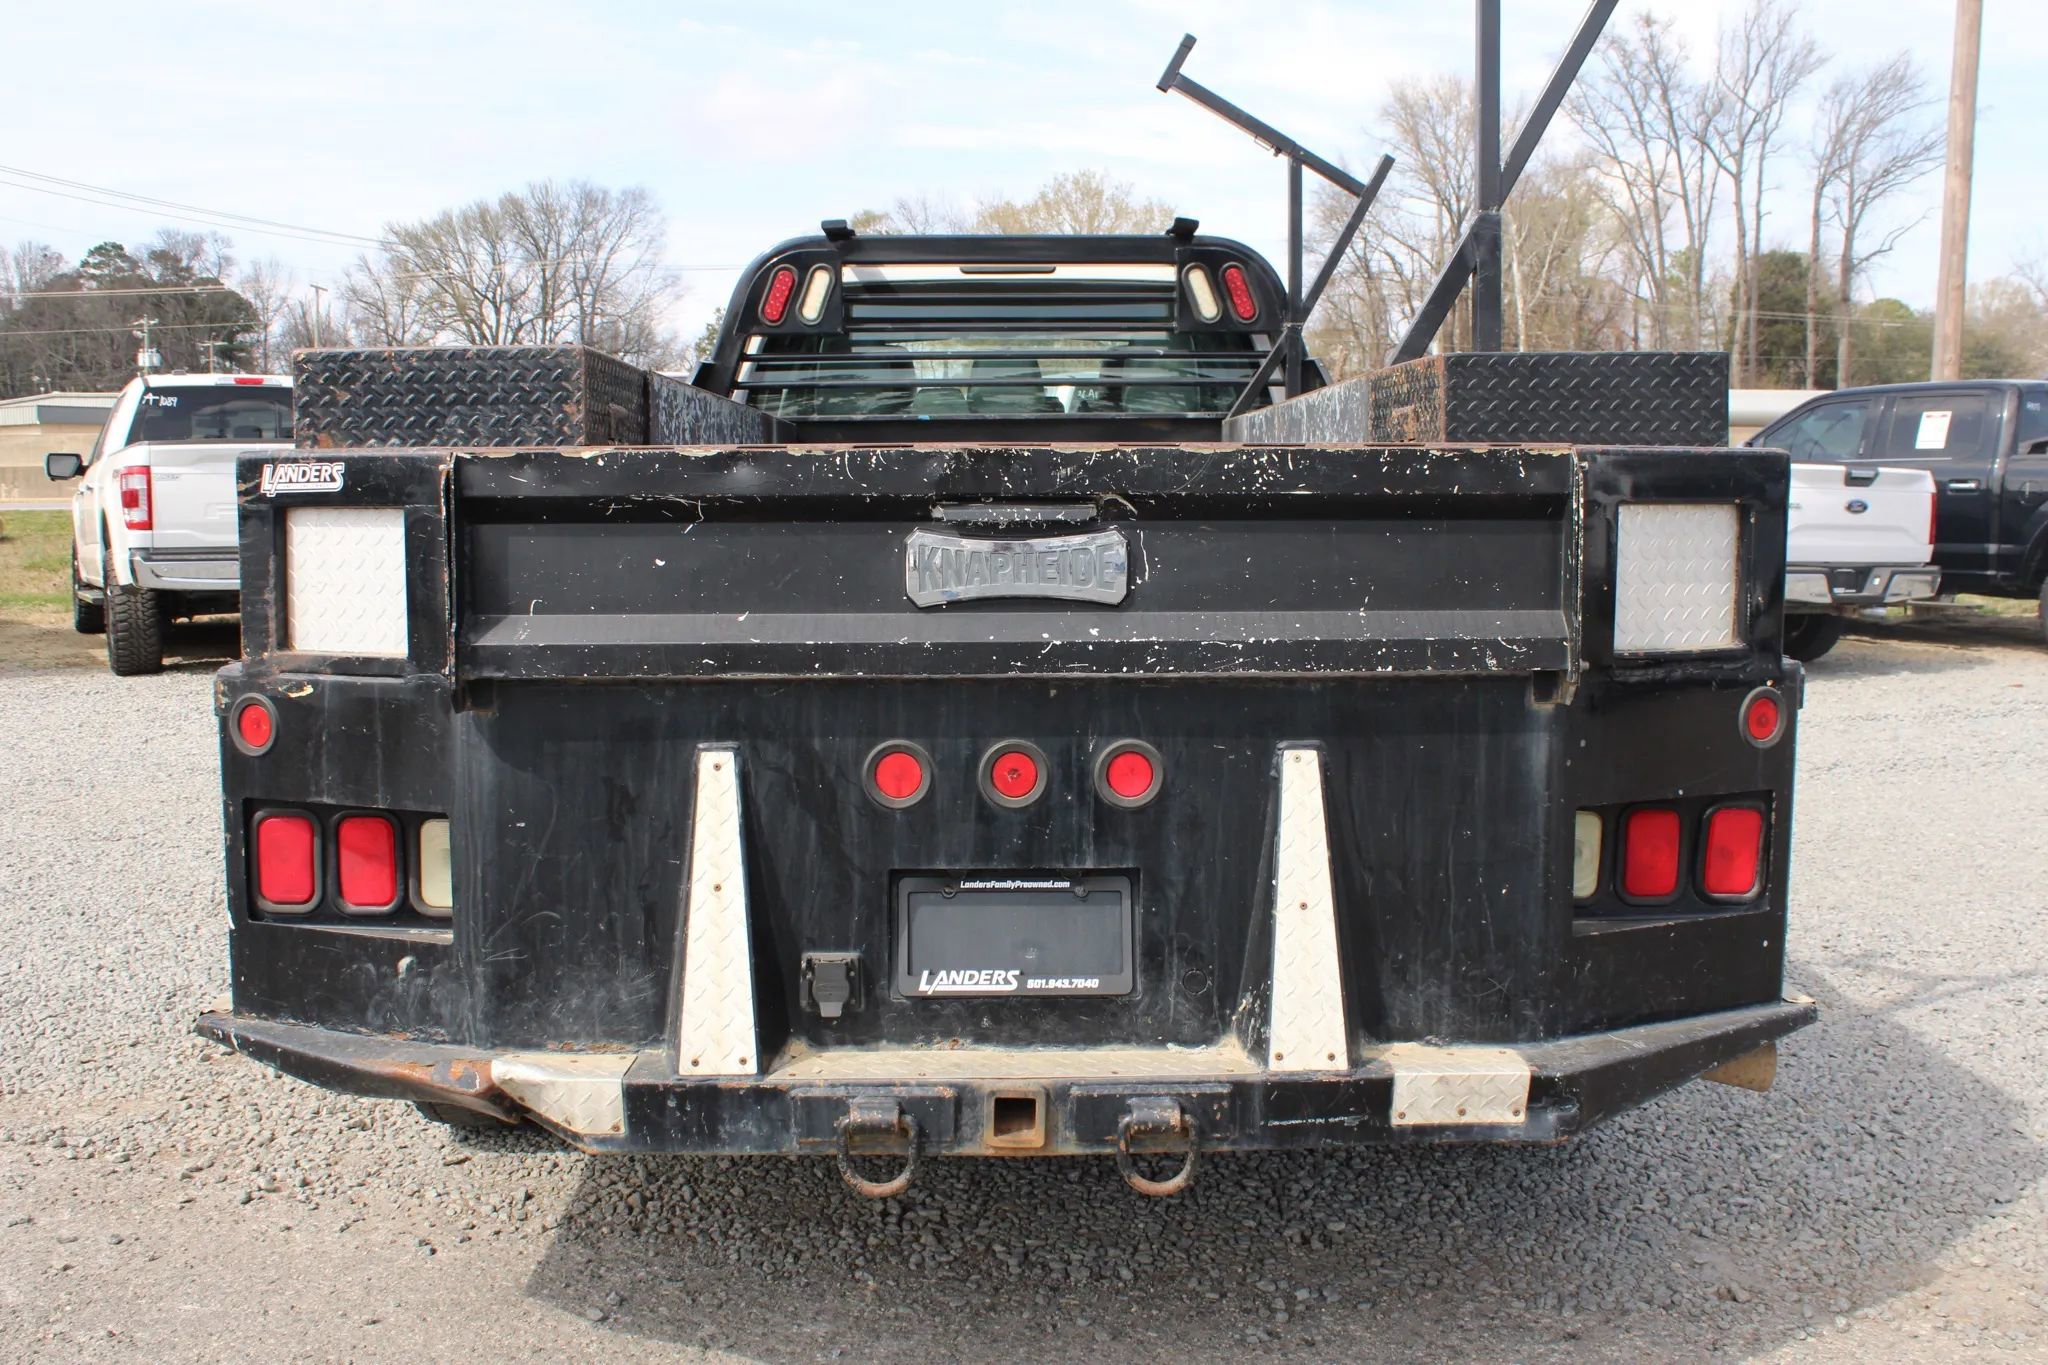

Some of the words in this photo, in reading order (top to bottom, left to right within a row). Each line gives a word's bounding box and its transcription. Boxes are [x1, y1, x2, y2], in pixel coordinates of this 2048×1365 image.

[261, 462, 345, 497] LANDERS
[918, 544, 1118, 593] KNAPHEIDE
[960, 880, 1071, 890] LandersFamilyPreowned.com
[918, 970, 1020, 995] LANDERS
